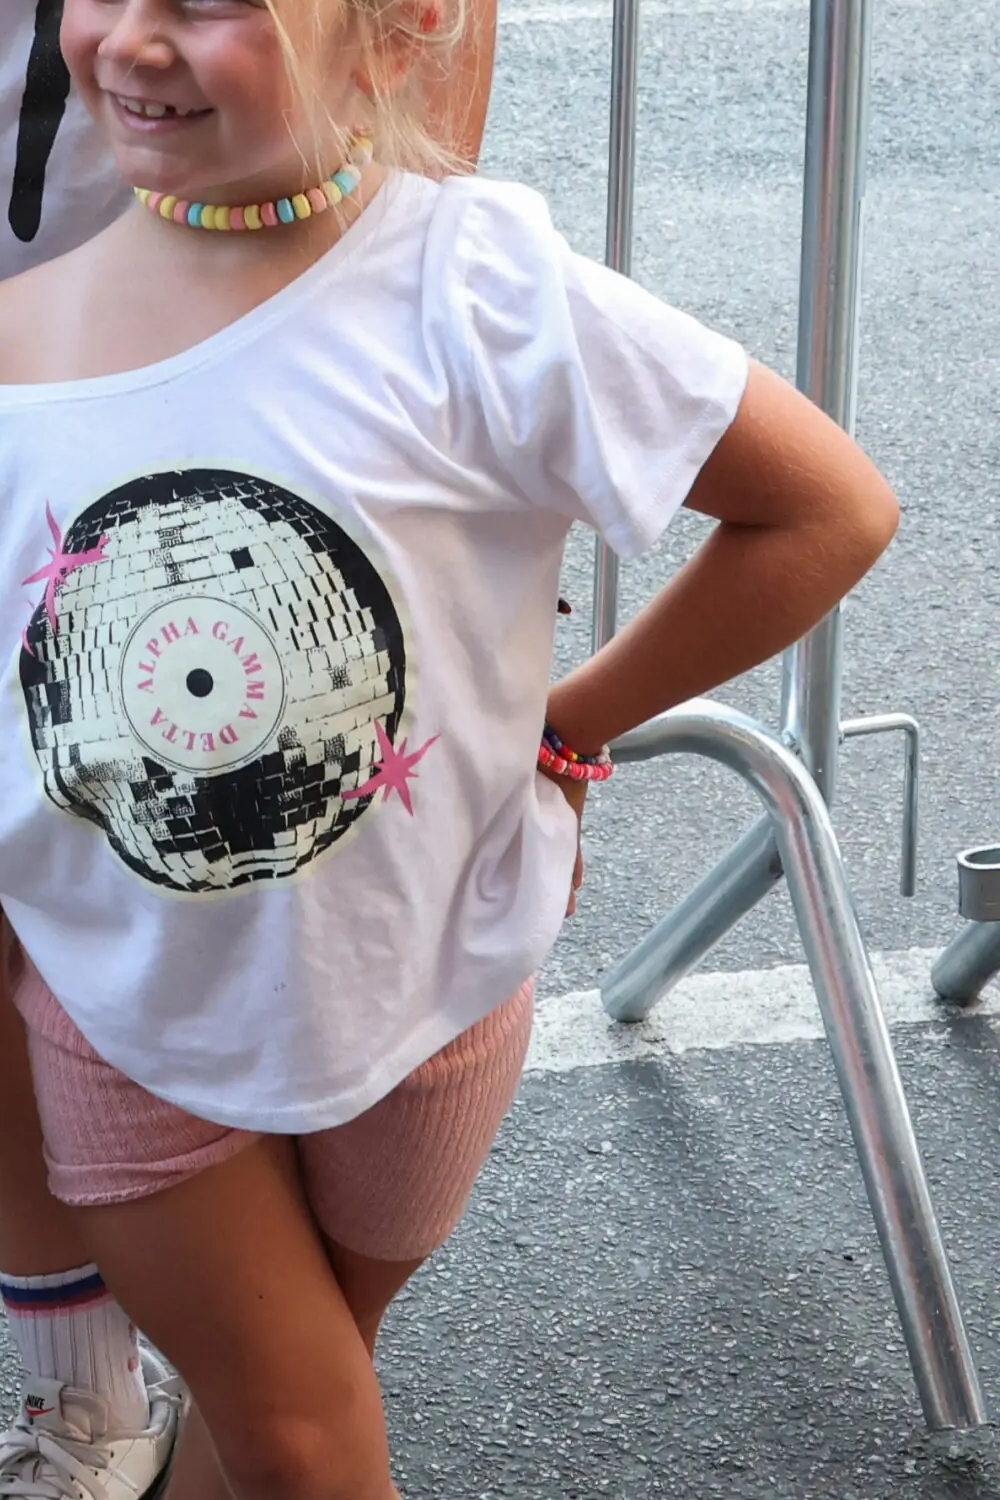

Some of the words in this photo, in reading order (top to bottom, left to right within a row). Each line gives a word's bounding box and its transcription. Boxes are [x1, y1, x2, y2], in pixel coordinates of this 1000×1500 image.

[137, 616, 200, 694] ALPHA
[211, 620, 265, 719] GAMMA
[150, 707, 239, 752] DELTA
